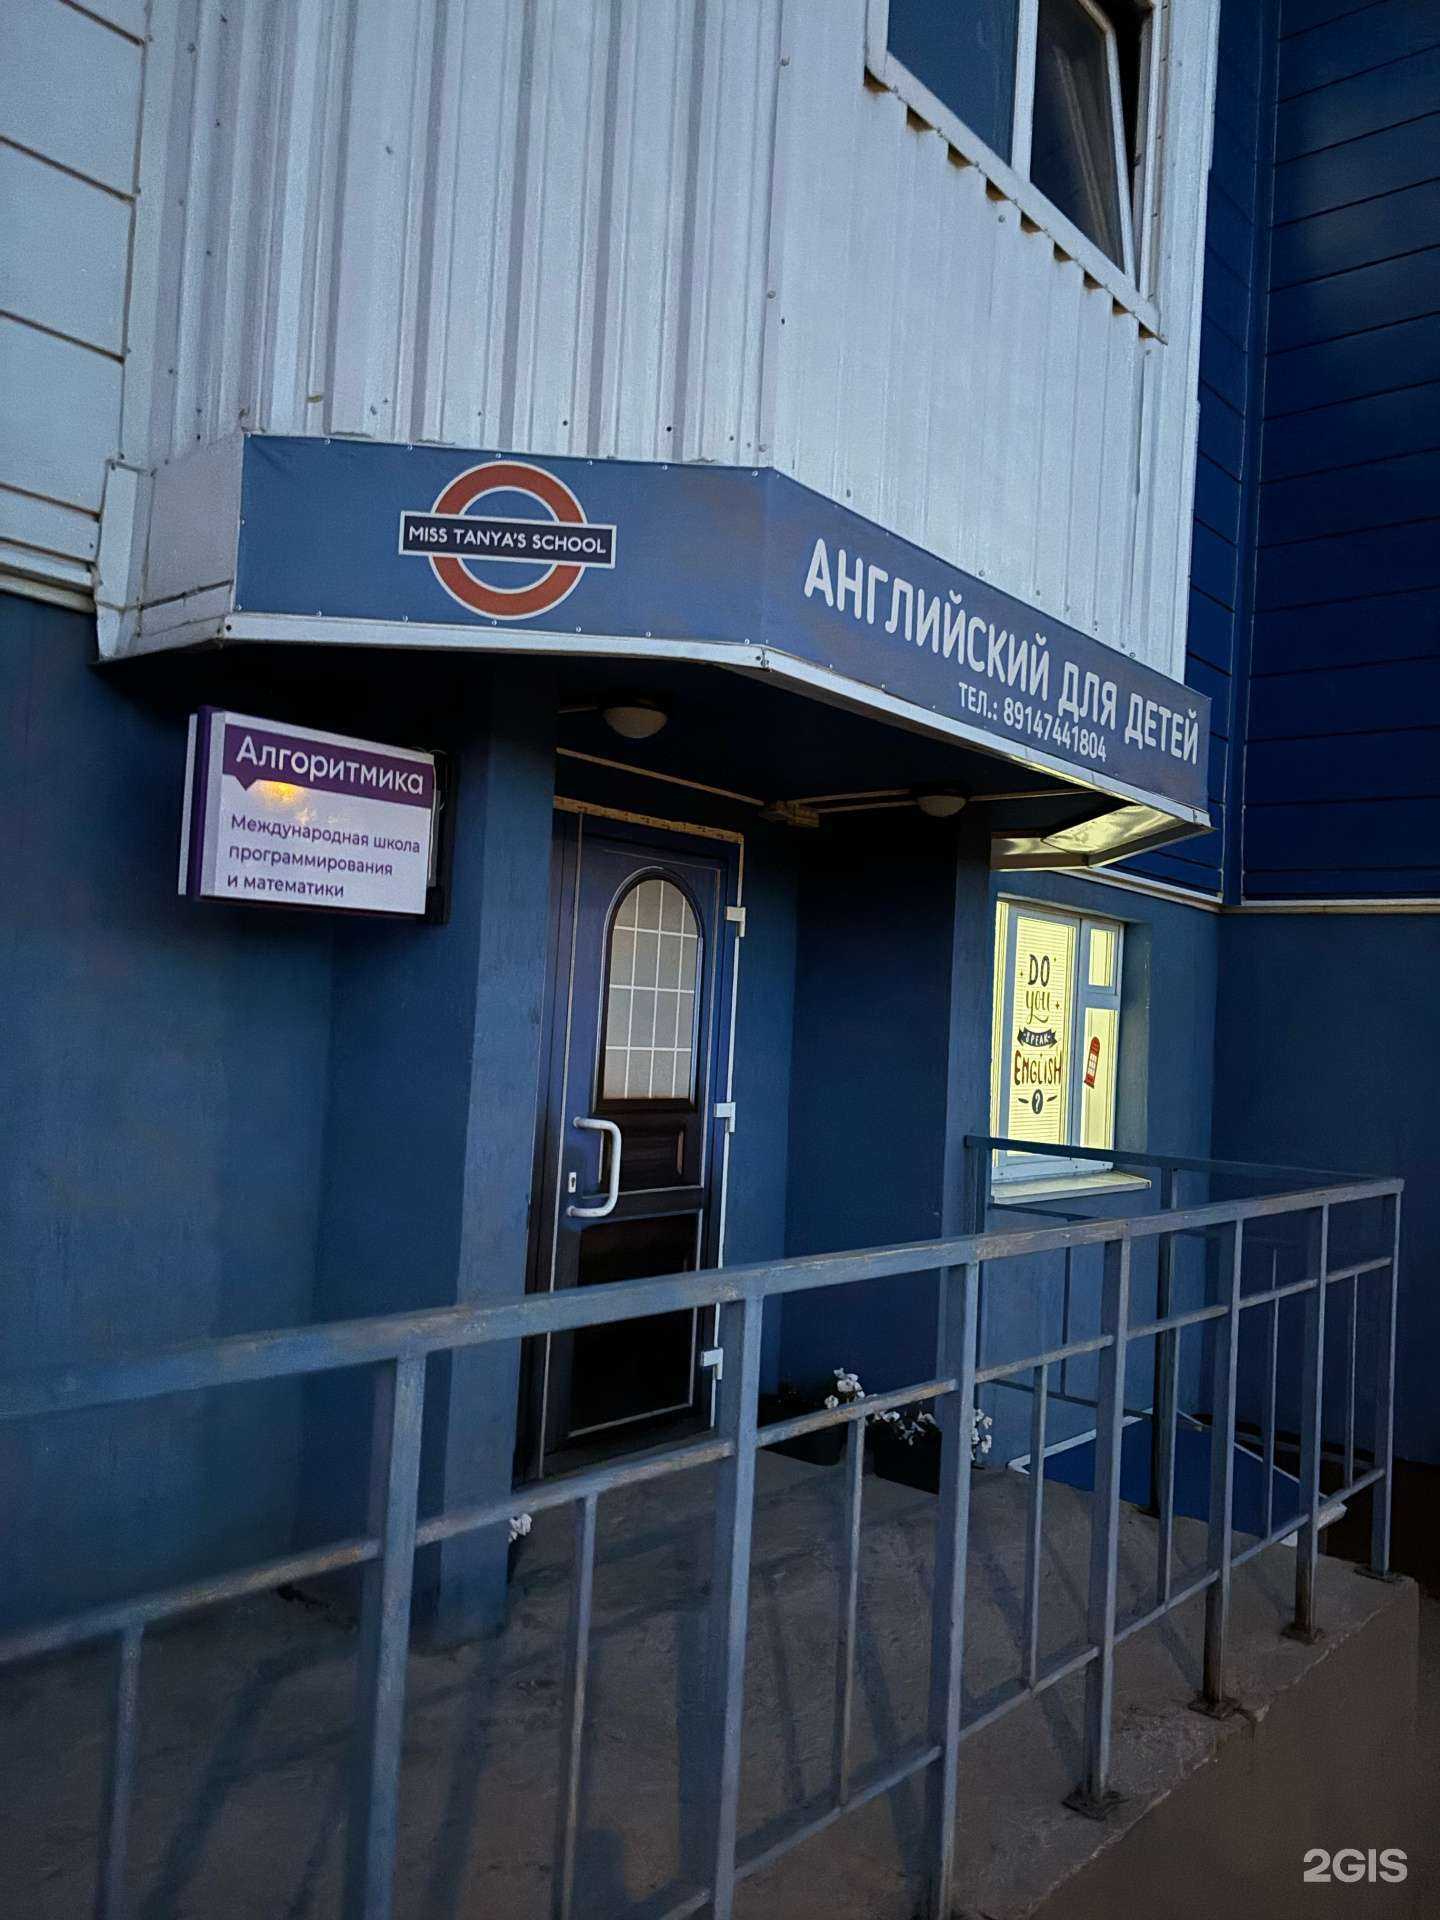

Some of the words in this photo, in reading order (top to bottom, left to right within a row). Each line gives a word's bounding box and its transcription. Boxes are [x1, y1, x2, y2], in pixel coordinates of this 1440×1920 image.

[408, 525, 448, 543] MISS
[453, 528, 527, 549] TANYA'S
[532, 535, 607, 554] SCHOOL
[804, 538, 1050, 701] АНГЛИЙСКИЙ
[1058, 661, 1118, 731] ДЛЯ
[1124, 692, 1200, 765] ДЕТЕЙ
[958, 681, 999, 721] ТЕЛ.:
[1003, 696, 1107, 763] 89147441804
[236, 735, 424, 795] Алгоритмика
[231, 814, 369, 847] Международная
[373, 838, 420, 854] школа
[229, 845, 393, 876] программирования
[227, 874, 238, 888] и
[243, 877, 344, 898] математики
[1027, 953, 1051, 987] DO
